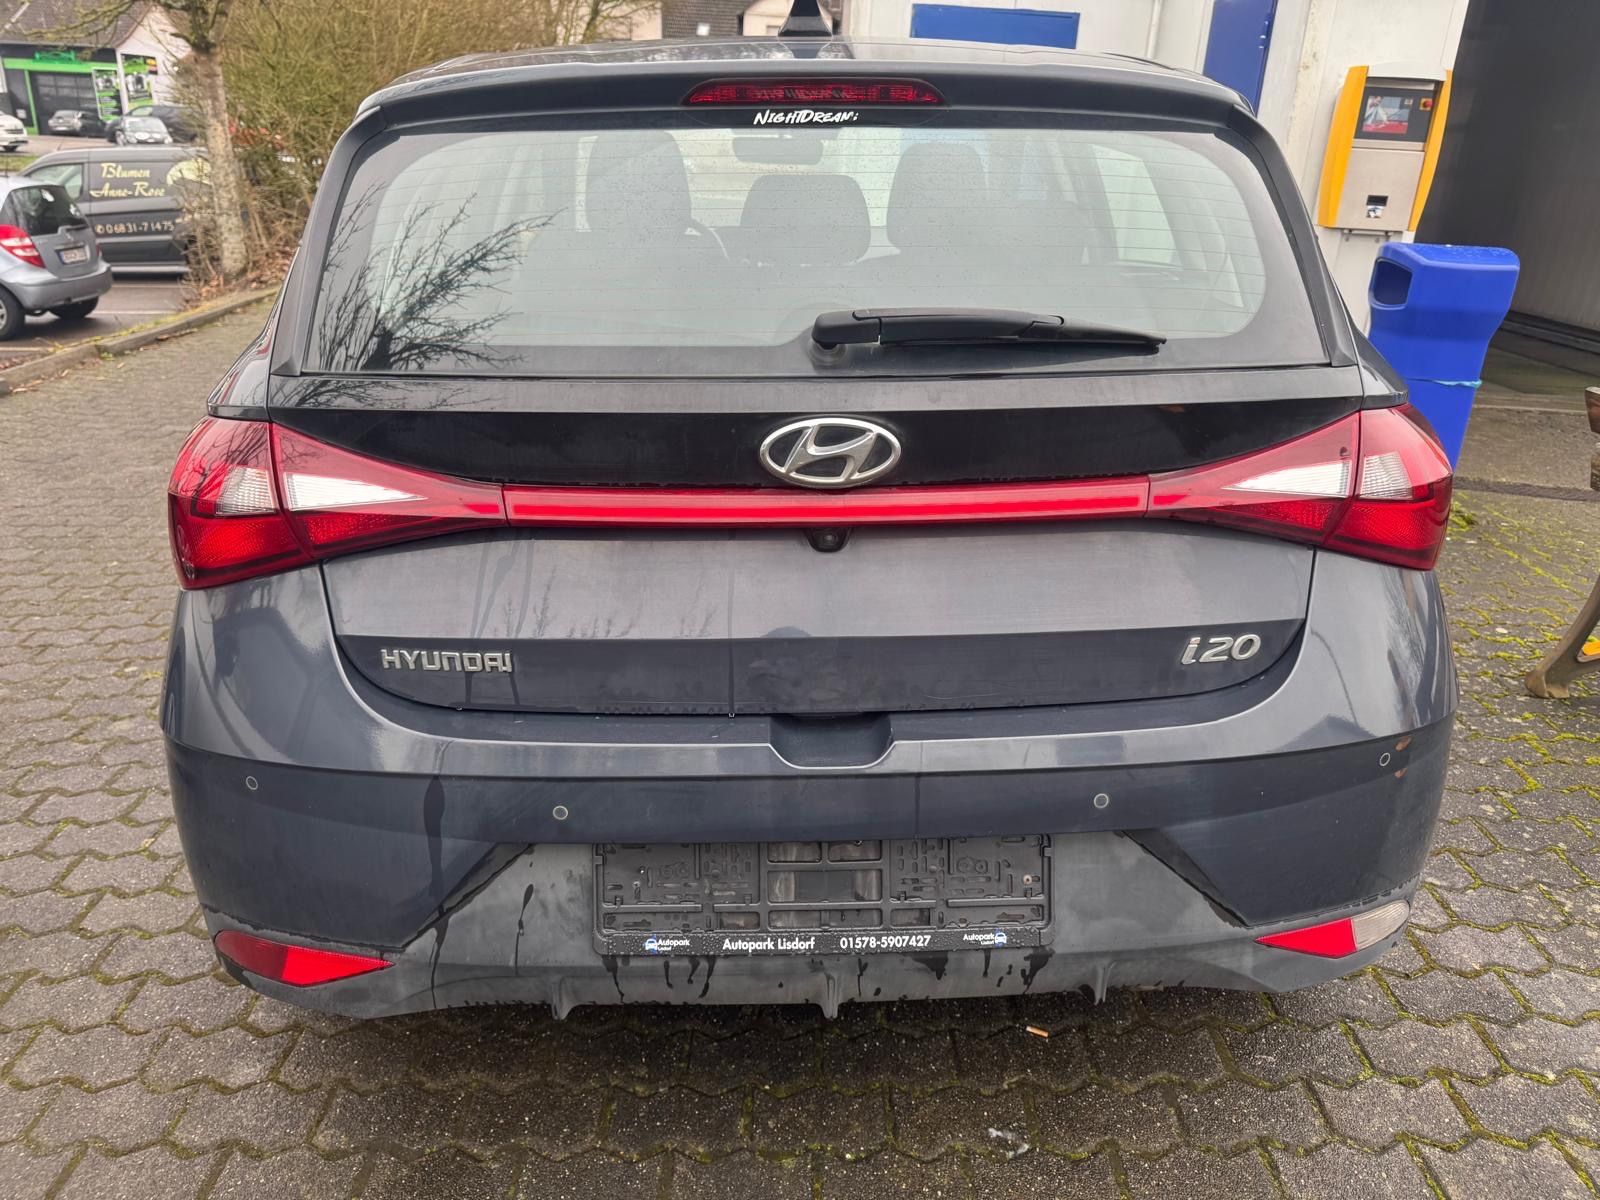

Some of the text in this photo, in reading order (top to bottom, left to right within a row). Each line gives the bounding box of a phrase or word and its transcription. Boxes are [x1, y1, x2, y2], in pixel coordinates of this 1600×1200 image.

[101, 162, 151, 178] Blumen
[89, 181, 166, 197] Anne-Rose
[1181, 634, 1262, 665] i20
[381, 649, 512, 673] HYUNDAI
[657, 939, 690, 947] Autopark
[722, 937, 816, 953] Autopark Lisdorf
[839, 935, 932, 949] 01578-5907427
[963, 932, 994, 942] Autopark
